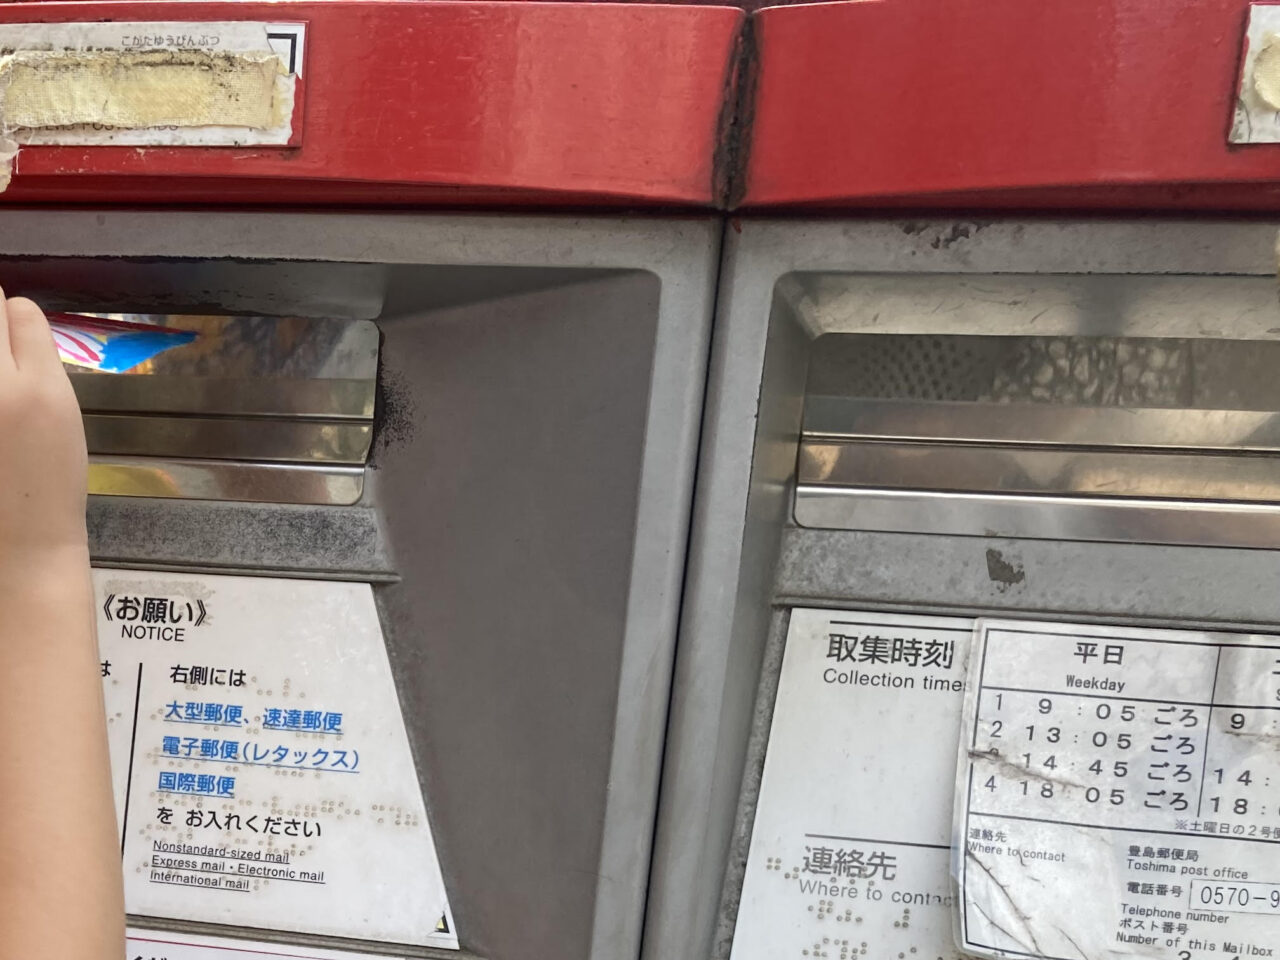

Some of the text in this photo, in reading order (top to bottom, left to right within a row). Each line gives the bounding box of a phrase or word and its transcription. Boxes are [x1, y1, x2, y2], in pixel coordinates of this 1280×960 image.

[121, 624, 185, 642] NOTICE
[826, 633, 955, 669] 取集時刻
[1074, 641, 1124, 665] 平日
[170, 664, 247, 687] 右側には
[823, 667, 915, 690] Collection
[1066, 674, 1126, 693] Weekday
[165, 700, 343, 733] 大型郵便、速達郵便
[1154, 706, 1199, 727] ごろ
[1150, 734, 1195, 755] ごろ
[158, 771, 236, 796] 国際郵便
[1147, 762, 1192, 783] ごろ
[1144, 789, 1189, 811] ごろ
[969, 828, 1008, 843] 連絡先
[153, 840, 290, 864] Nonstandard-sized mail
[968, 841, 1066, 862] Where to contact
[1128, 845, 1200, 862] 豊島郵便局
[151, 855, 325, 883] Express mail Electronic mail
[802, 845, 898, 881] 連絡先
[1126, 858, 1250, 880] Toshima post office
[150, 870, 251, 891] International mail
[799, 878, 859, 899] Where
[866, 884, 884, 902] to
[1127, 881, 1184, 898] 電話番号
[1121, 903, 1230, 924] Telephone number
[1120, 918, 1188, 936] ポスト番号
[1116, 931, 1274, 957] Number of this Mailbox
